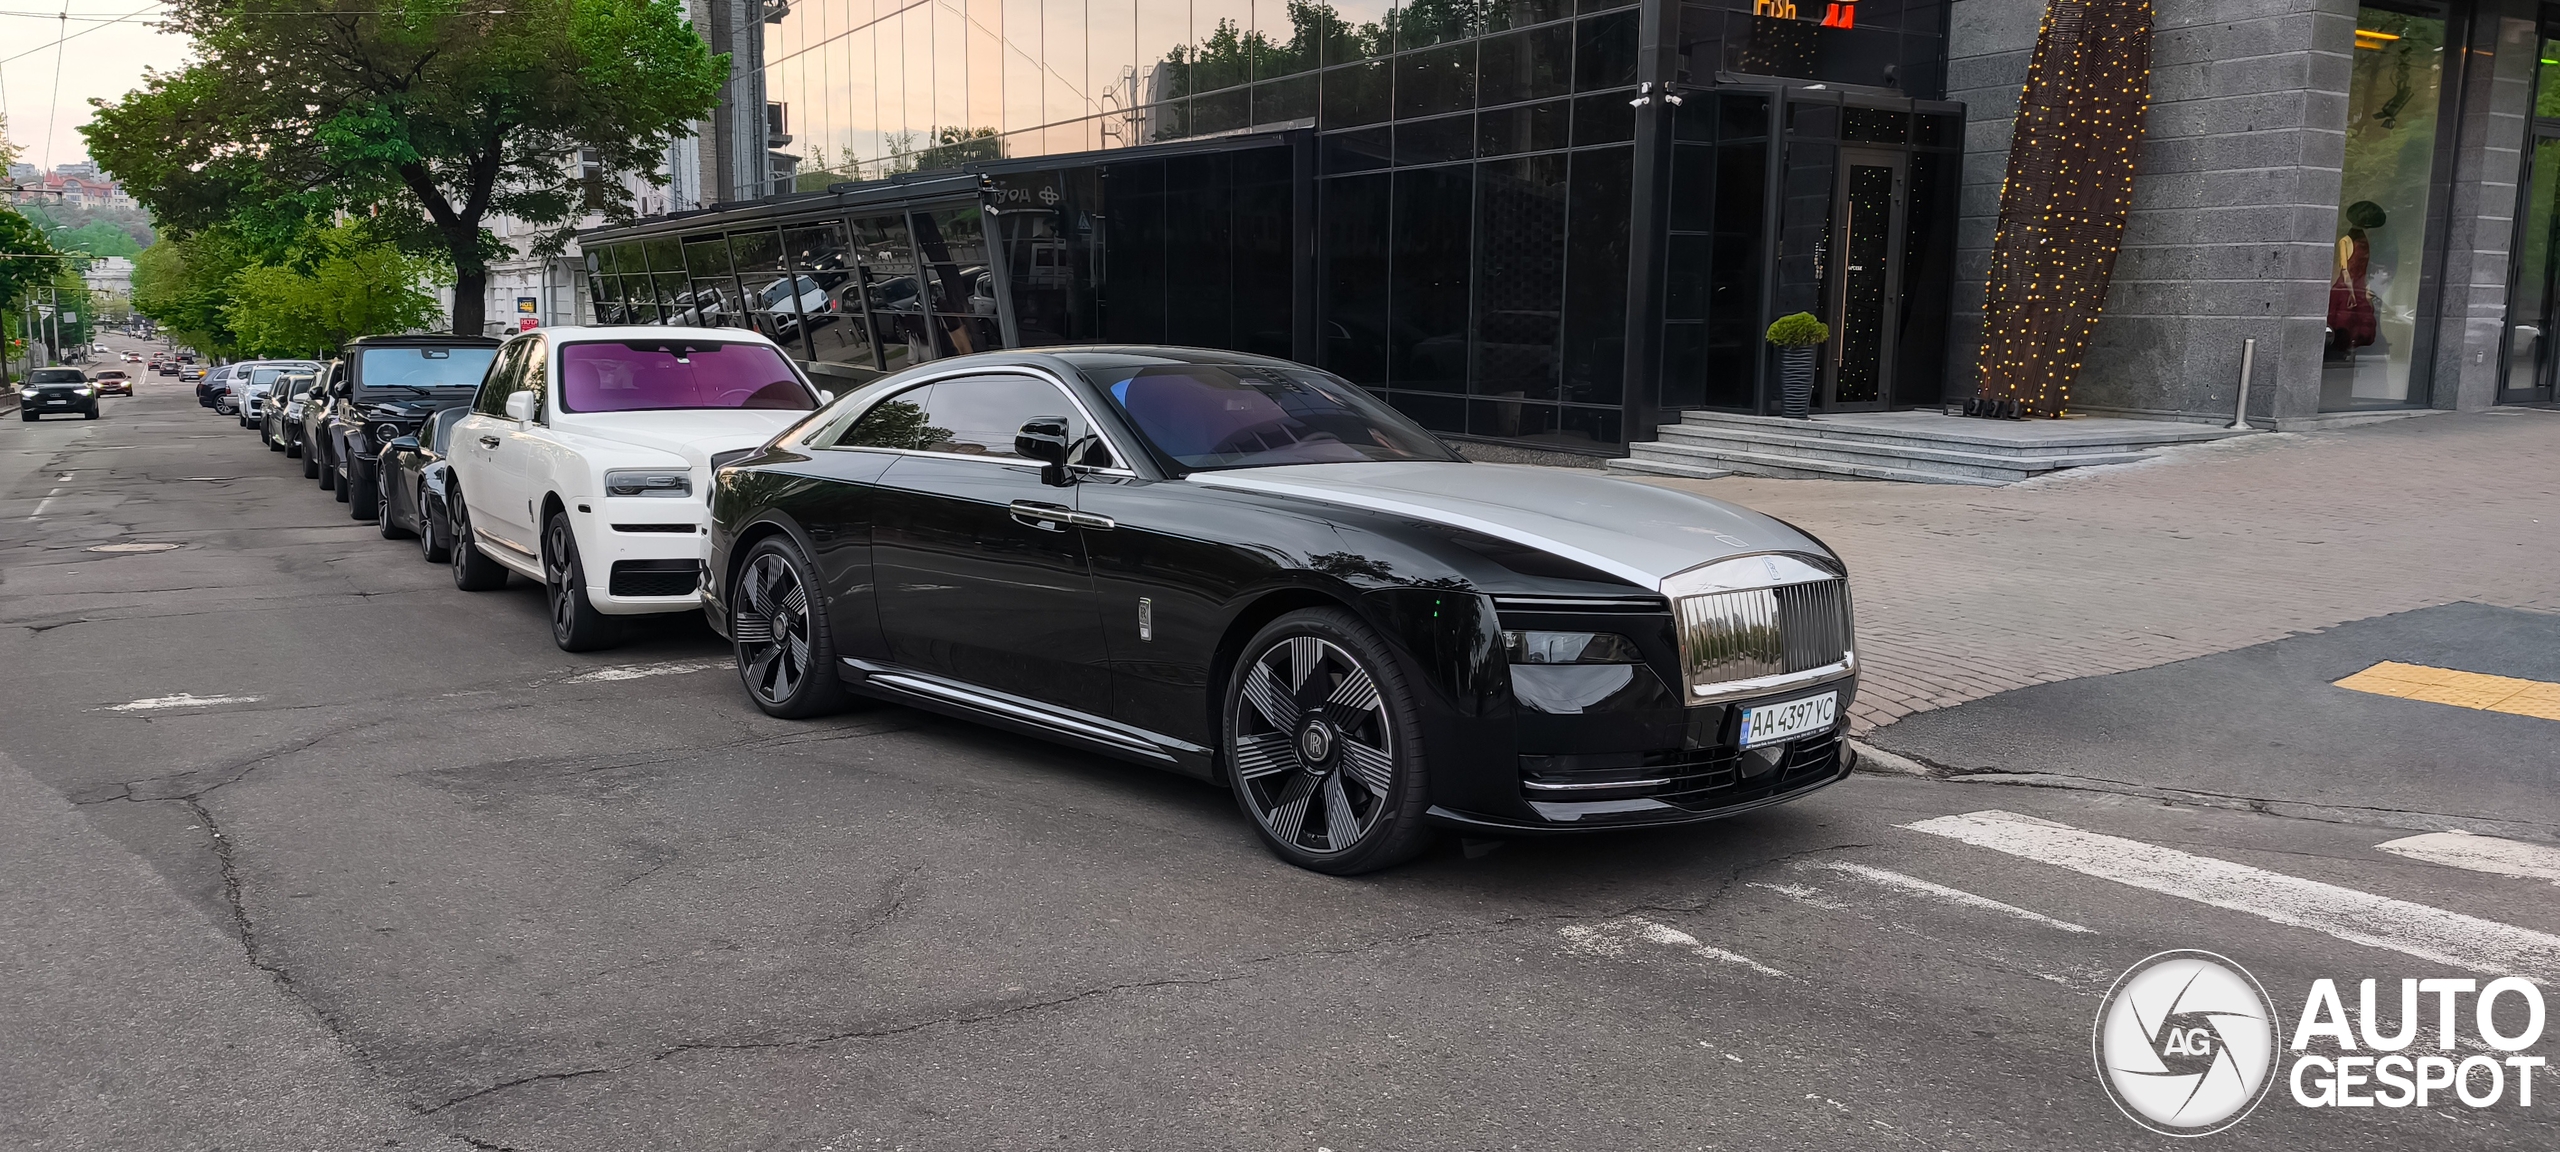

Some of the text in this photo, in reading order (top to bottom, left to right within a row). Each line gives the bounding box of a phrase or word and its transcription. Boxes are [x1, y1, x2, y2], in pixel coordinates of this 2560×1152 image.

[1750, 709, 1774, 738] AA
[1777, 701, 1814, 732] 4397
[1816, 697, 1834, 724] YC
